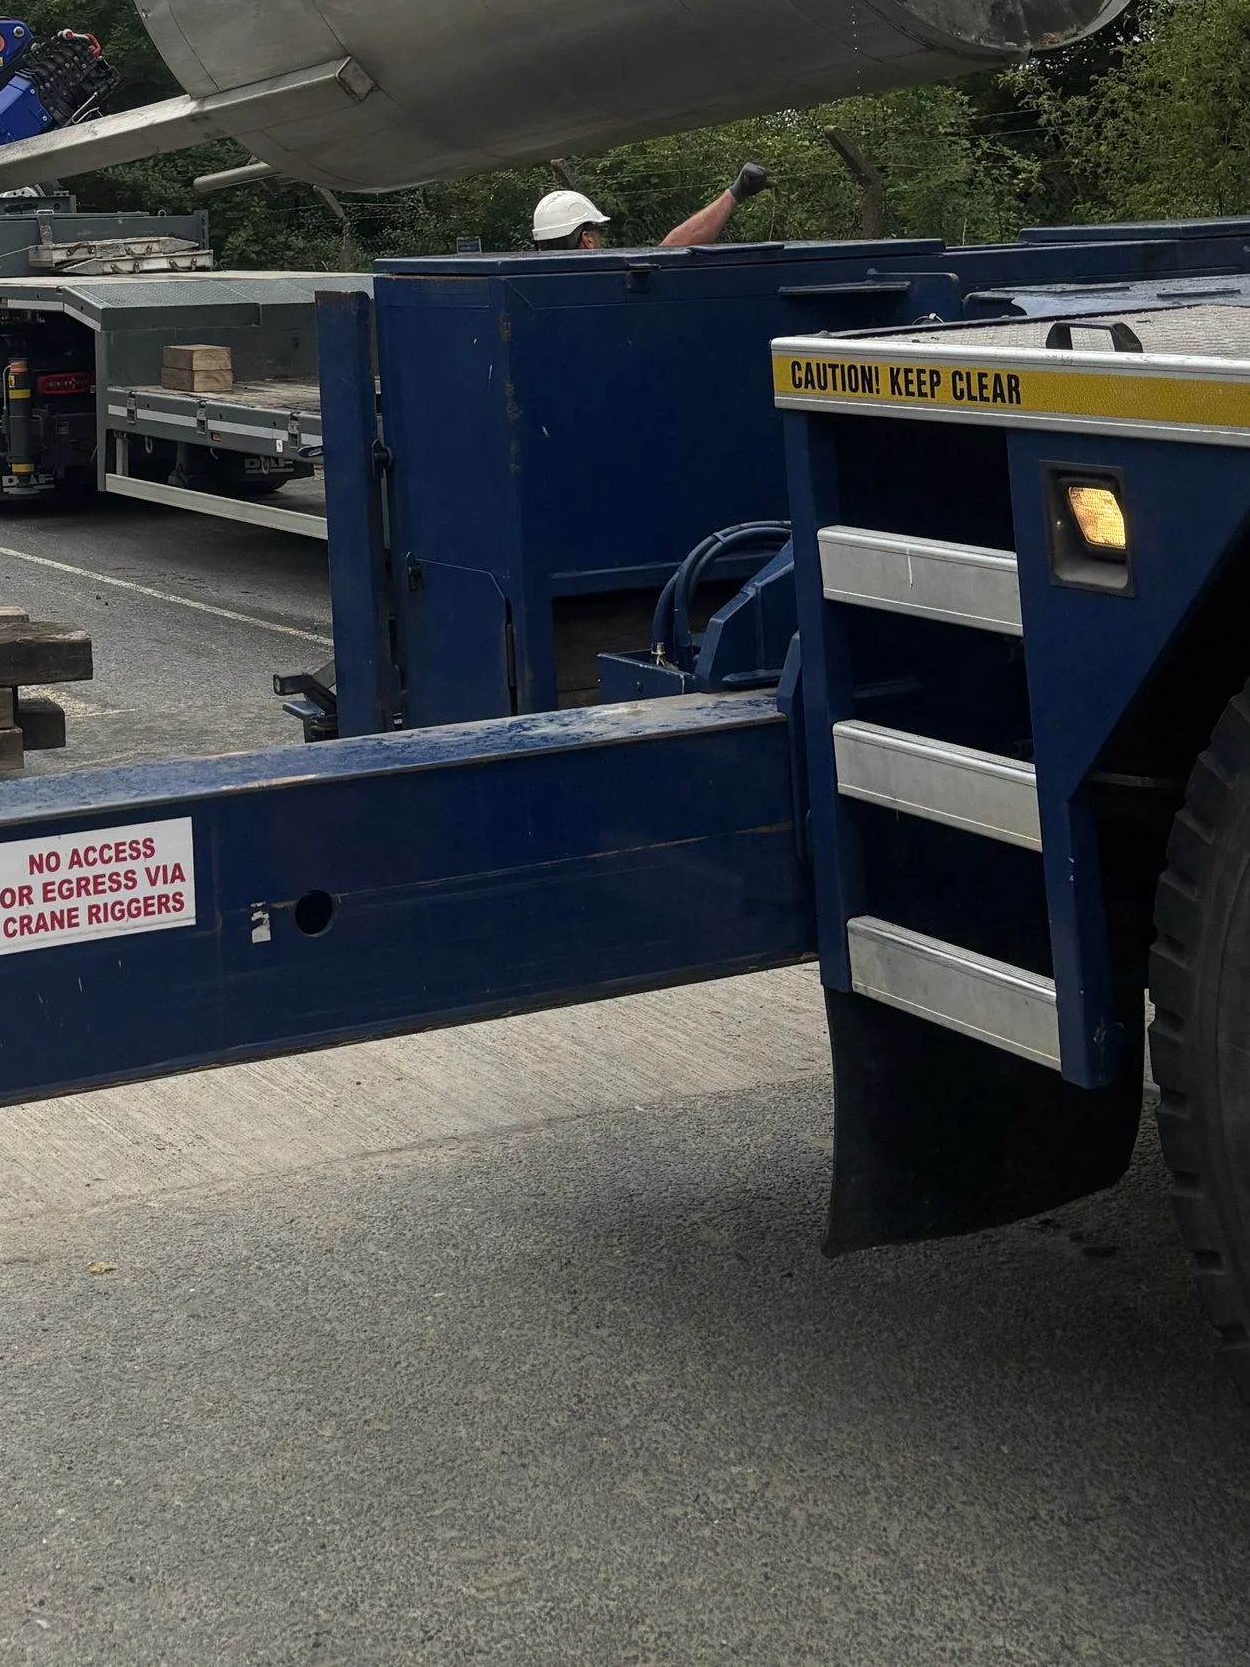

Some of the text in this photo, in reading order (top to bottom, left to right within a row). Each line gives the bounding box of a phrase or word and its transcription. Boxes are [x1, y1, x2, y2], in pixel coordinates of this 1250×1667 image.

[791, 360, 1022, 405] CAUTION! KEEP CLEAR
[28, 837, 156, 876] NO ACCESS
[0, 862, 186, 909] OR EGRESS VIA
[2, 891, 185, 939] CRANE RIGGERS
